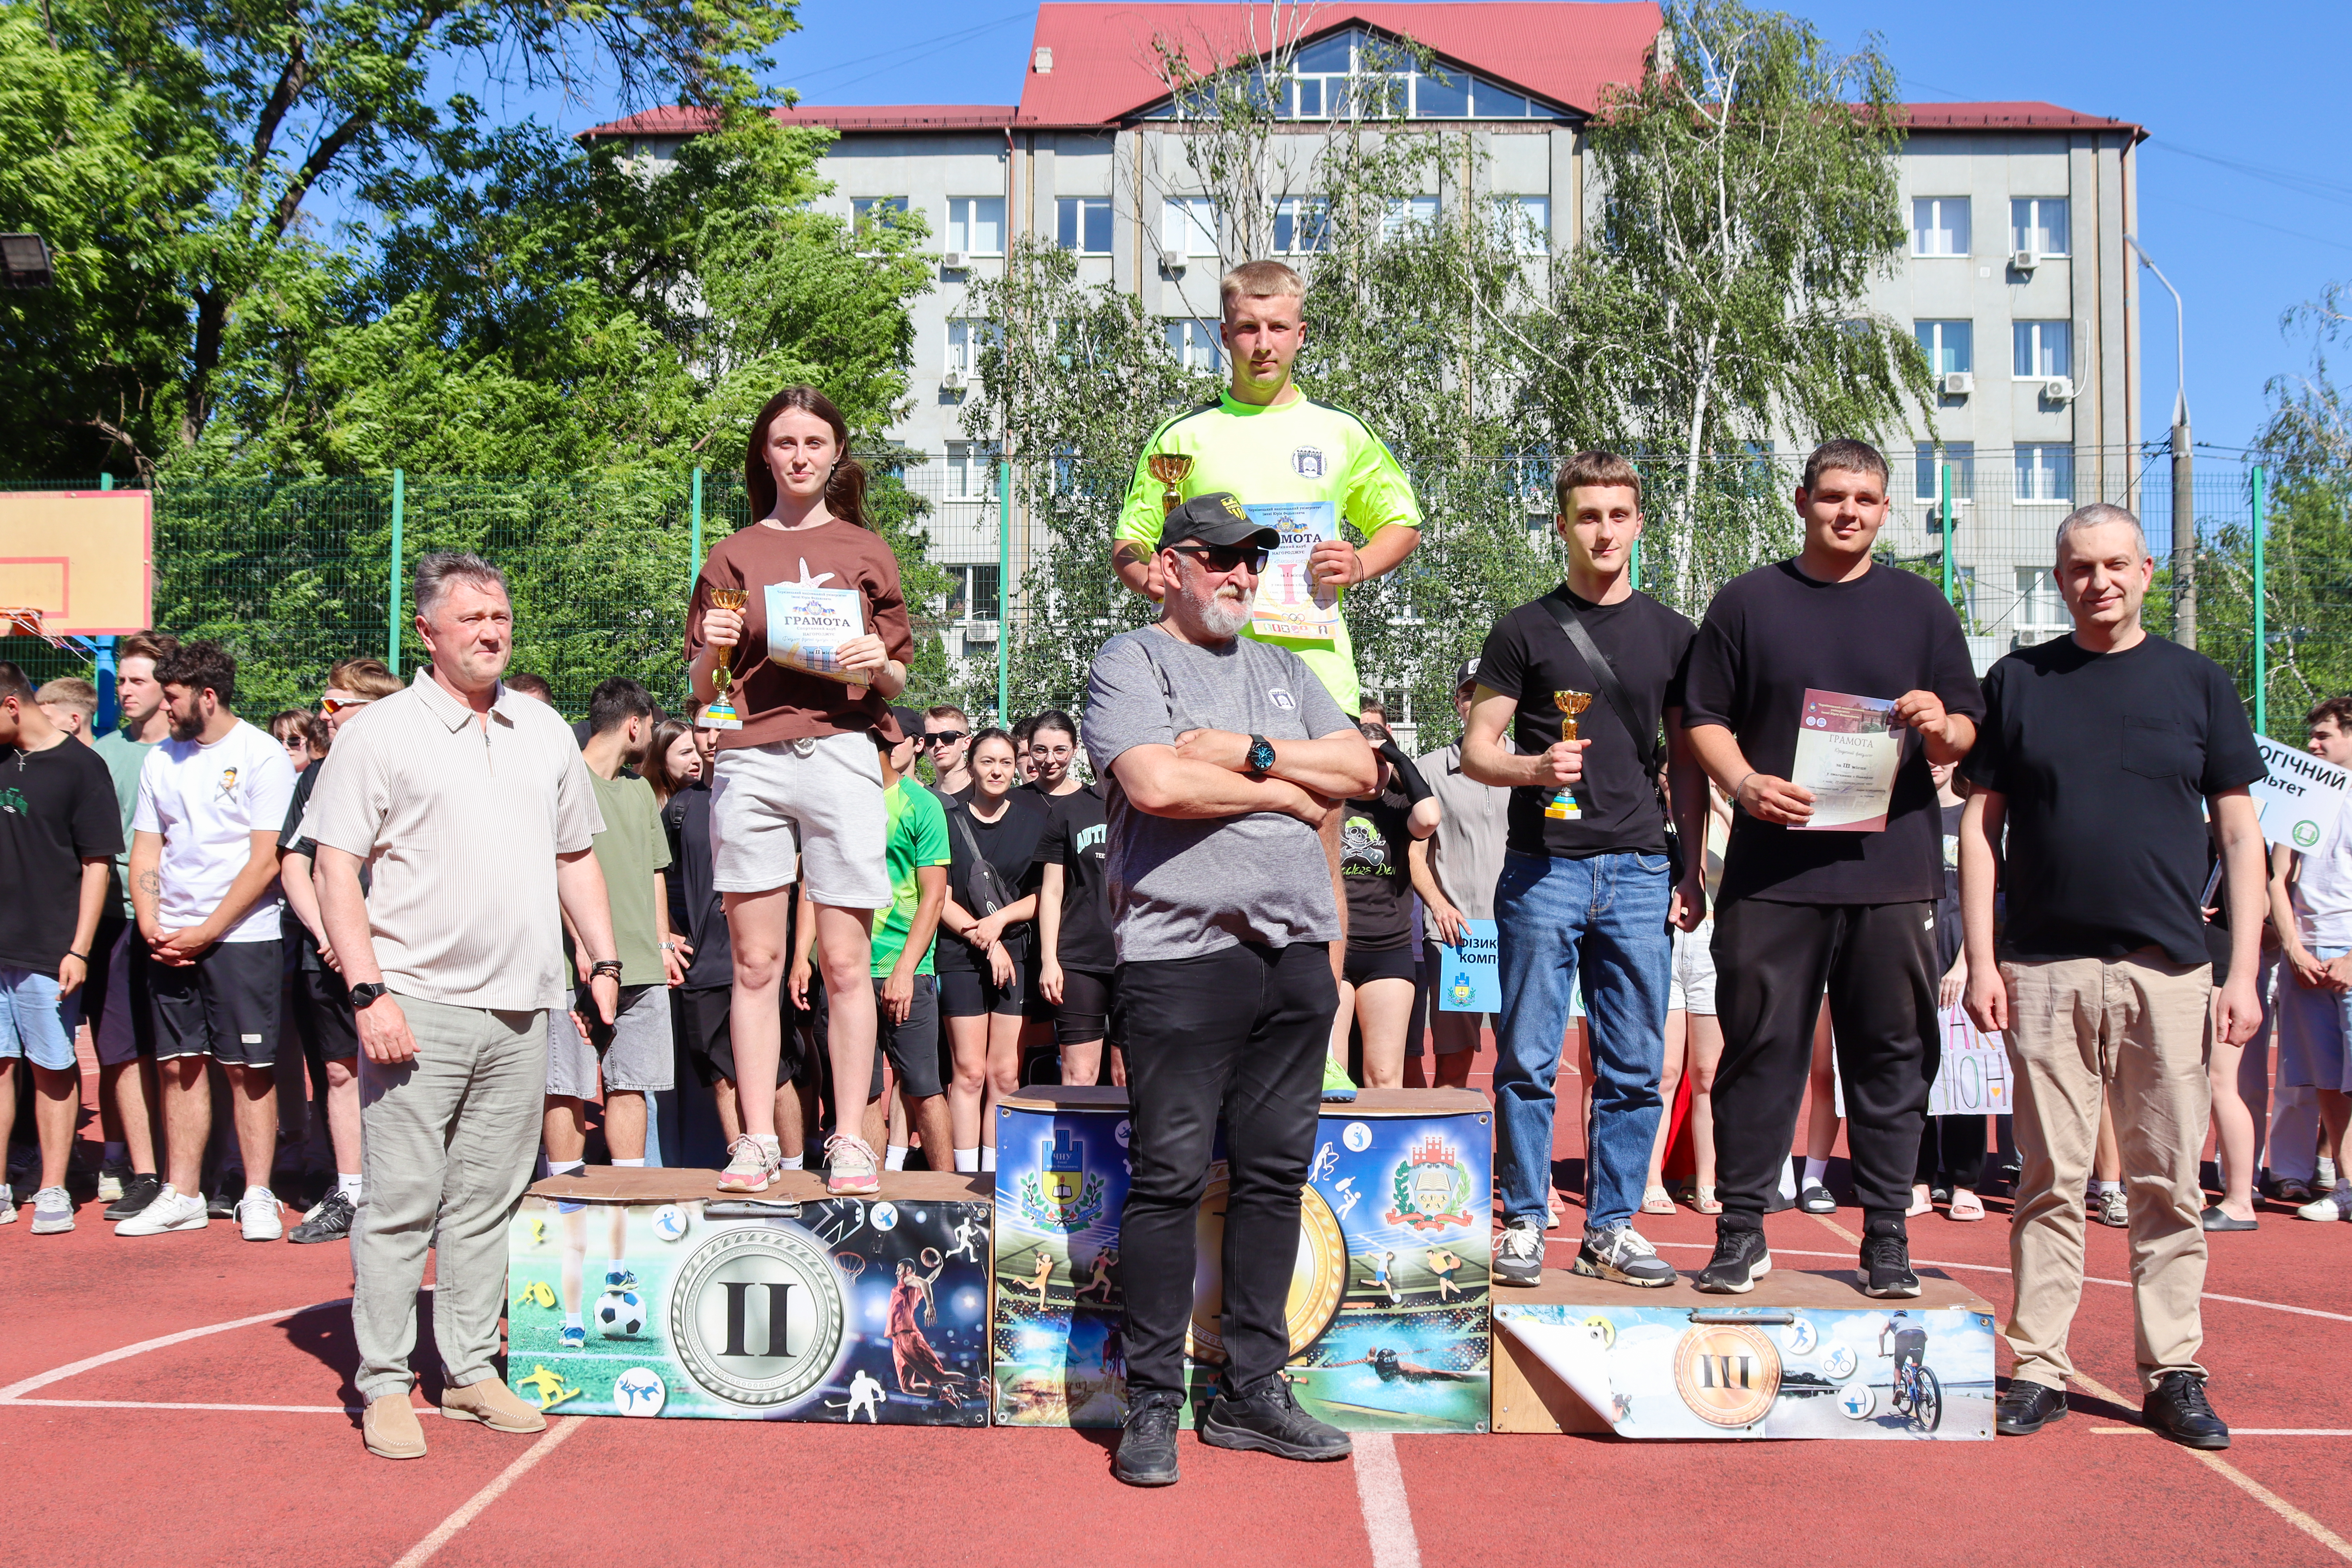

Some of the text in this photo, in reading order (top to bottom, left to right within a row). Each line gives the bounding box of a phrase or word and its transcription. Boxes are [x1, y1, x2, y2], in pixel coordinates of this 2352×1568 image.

[1280, 533, 1322, 544] МОТА
[784, 616, 851, 627] ГРАМОТА
[1829, 734, 1873, 748] ГРАМОТА
[2258, 745, 2347, 790] ОГІЧНИЙ
[1462, 938, 1497, 949] ФІЗИК
[1460, 953, 1497, 964] КОМП
[1024, 1205, 1102, 1219] VIVAT ACADEMIA
[717, 1281, 797, 1358] II
[1699, 1354, 1753, 1390] III
